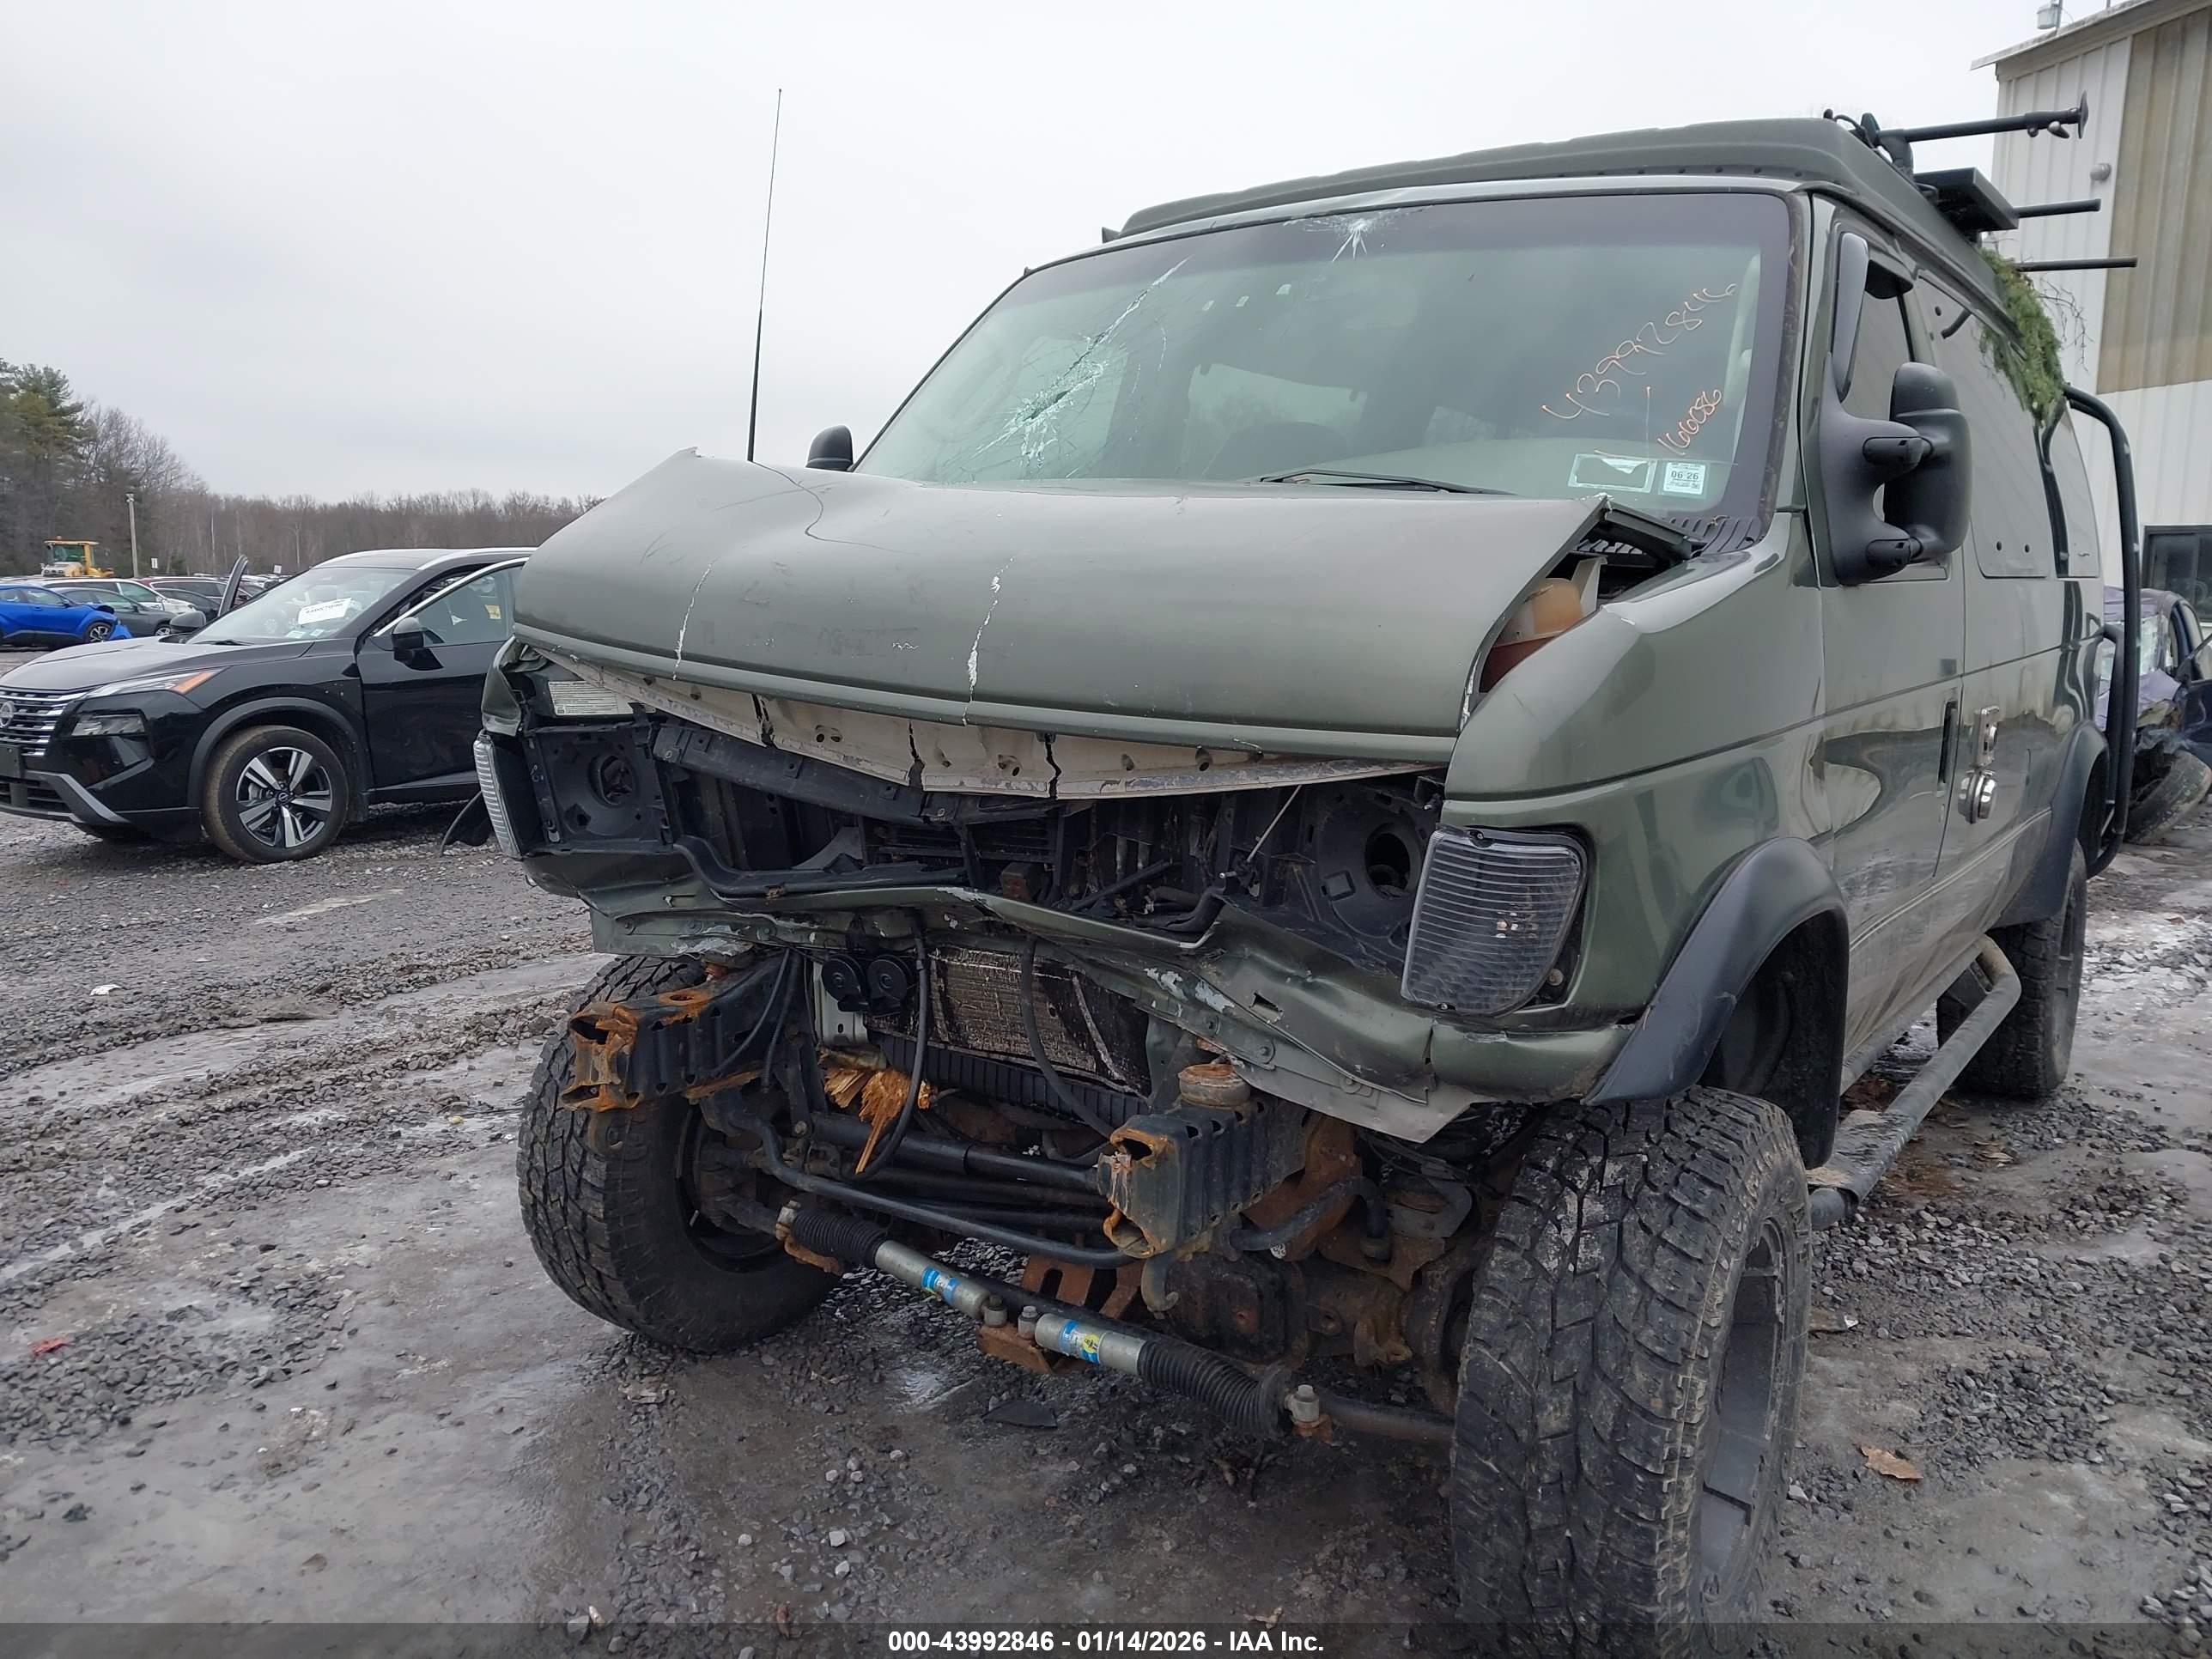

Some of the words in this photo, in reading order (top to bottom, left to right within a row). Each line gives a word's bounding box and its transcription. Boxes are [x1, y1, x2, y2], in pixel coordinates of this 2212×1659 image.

[1541, 283, 1738, 420] 43992846
[1670, 470, 1683, 479] 06
[1686, 471, 1699, 480] 26
